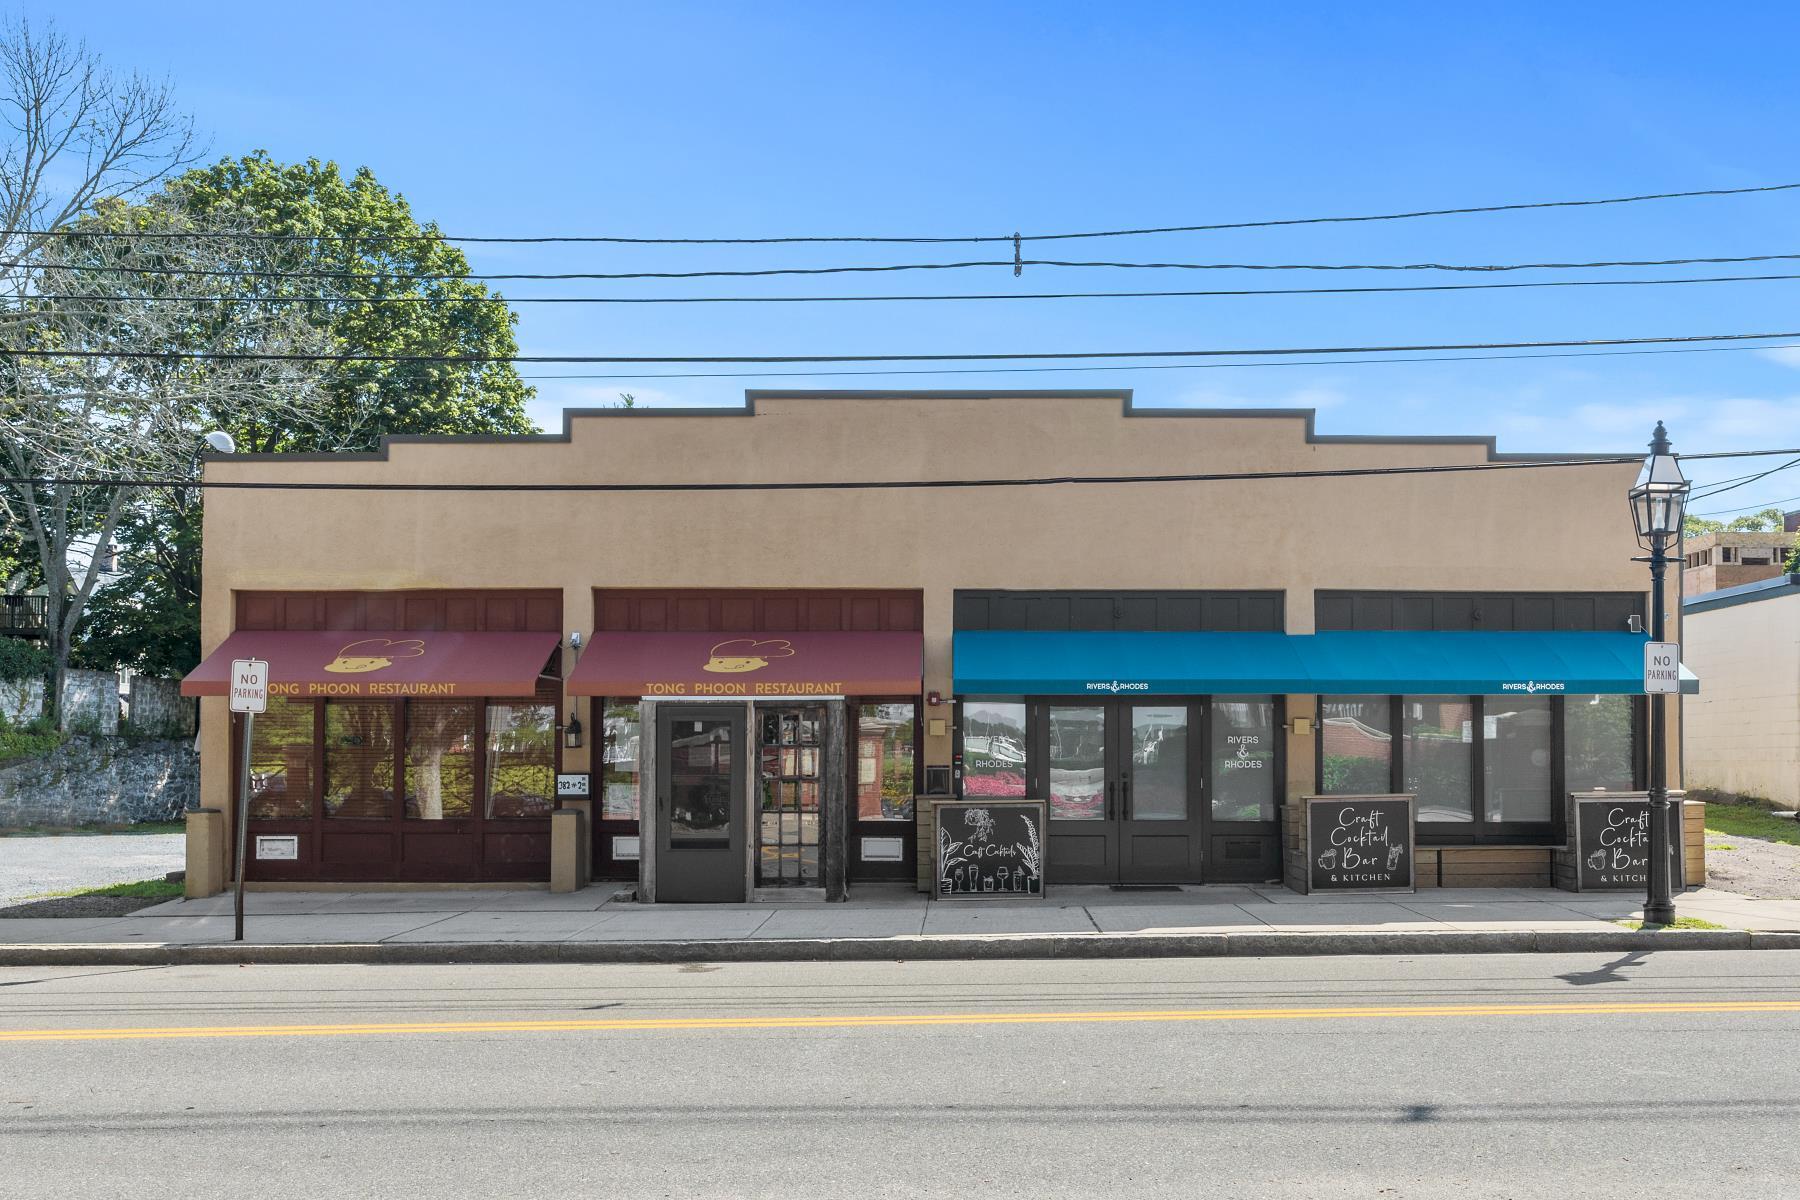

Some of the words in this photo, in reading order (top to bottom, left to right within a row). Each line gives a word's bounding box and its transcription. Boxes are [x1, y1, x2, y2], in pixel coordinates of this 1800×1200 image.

[1653, 655, 1671, 667] NO
[240, 673, 258, 685] NO
[1647, 669, 1677, 681] PARKING
[233, 687, 264, 700] PARKING
[267, 683, 300, 695] ONG
[309, 683, 360, 694] PHOON
[369, 683, 456, 694] RESTAURANT
[646, 683, 685, 694] TONG
[694, 683, 746, 694] PHOON
[755, 682, 842, 694] RESTAURANT
[1227, 735, 1259, 744] RIVERS
[975, 760, 1013, 768] RHODES
[1224, 760, 1263, 769] RHODES
[1339, 807, 1384, 829] Craft
[1608, 807, 1650, 830] Craft
[1330, 826, 1389, 847] Cocktail
[1600, 826, 1649, 848] Cockta
[963, 844, 985, 859] Craft
[985, 843, 1017, 858] Cocktails
[1341, 847, 1378, 870] Bar
[1611, 847, 1649, 870] Bar
[1331, 874, 1338, 882] &
[1343, 873, 1391, 882] KITCHEN
[1613, 874, 1648, 882] KITCH
